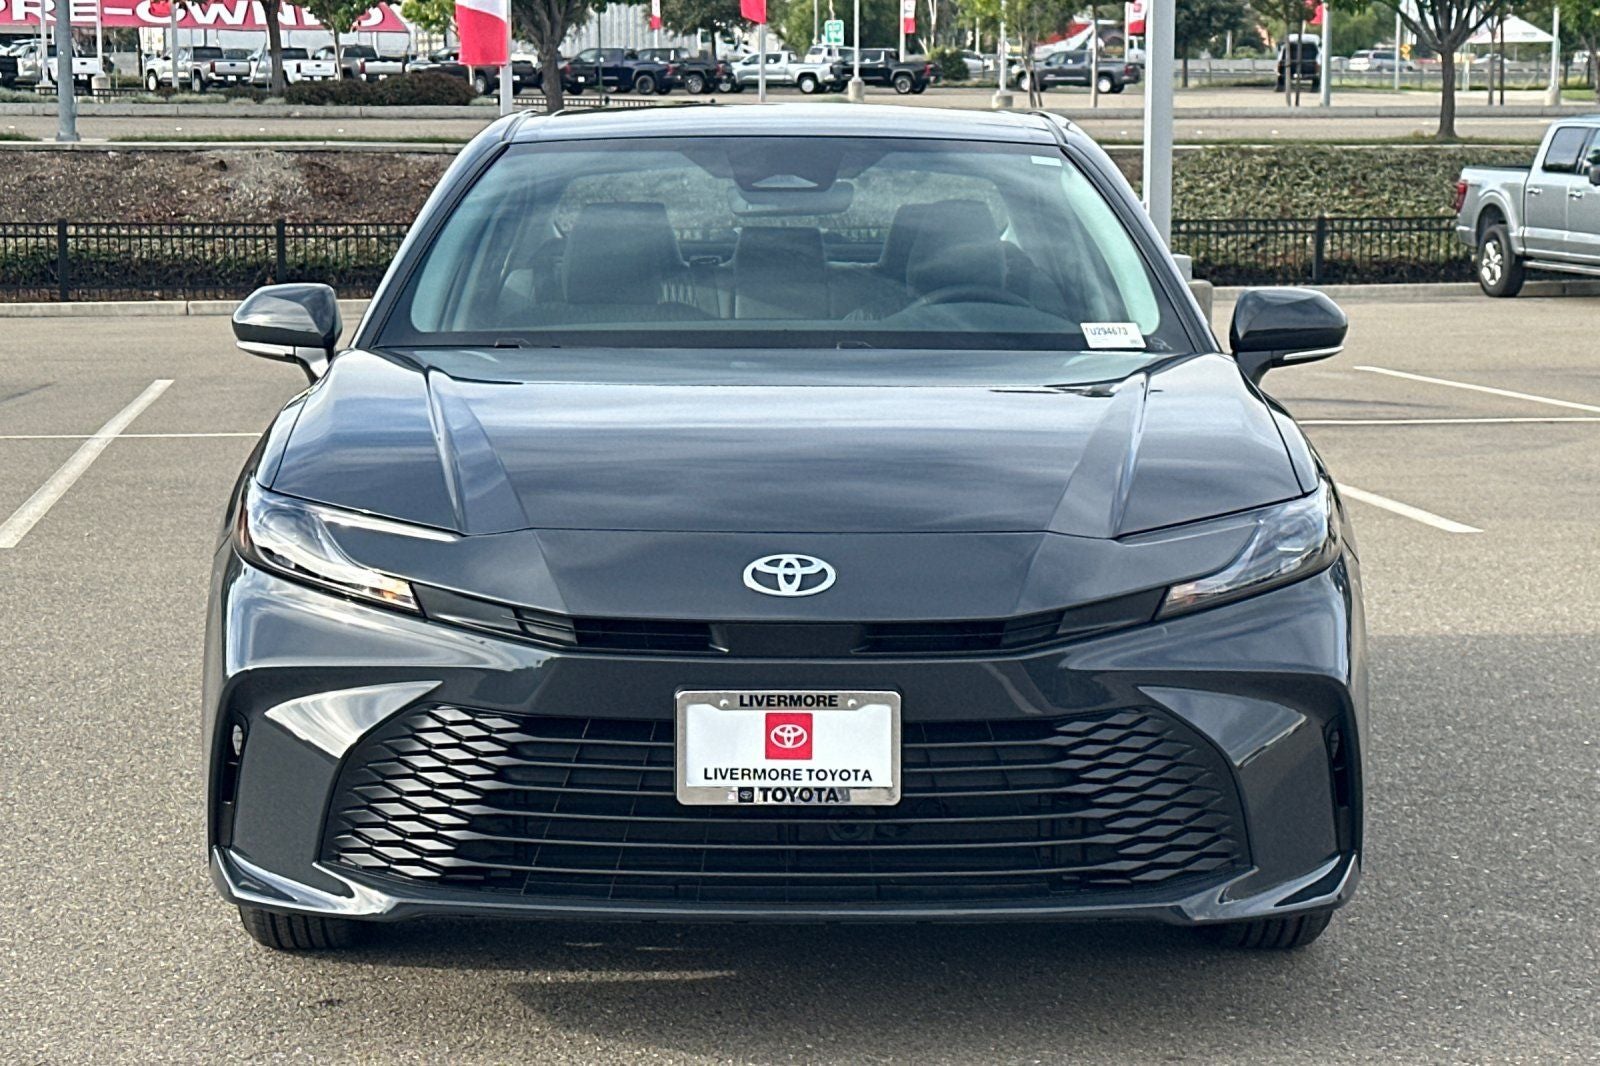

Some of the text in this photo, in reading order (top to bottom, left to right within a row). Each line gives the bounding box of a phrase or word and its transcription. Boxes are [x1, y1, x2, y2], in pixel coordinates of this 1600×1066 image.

[0, 0, 384, 27] RE-OWND
[739, 694, 838, 707] LIVERMORE
[703, 767, 873, 782] LIVERMORE TOYOTA
[759, 786, 839, 802] TOYOTA
